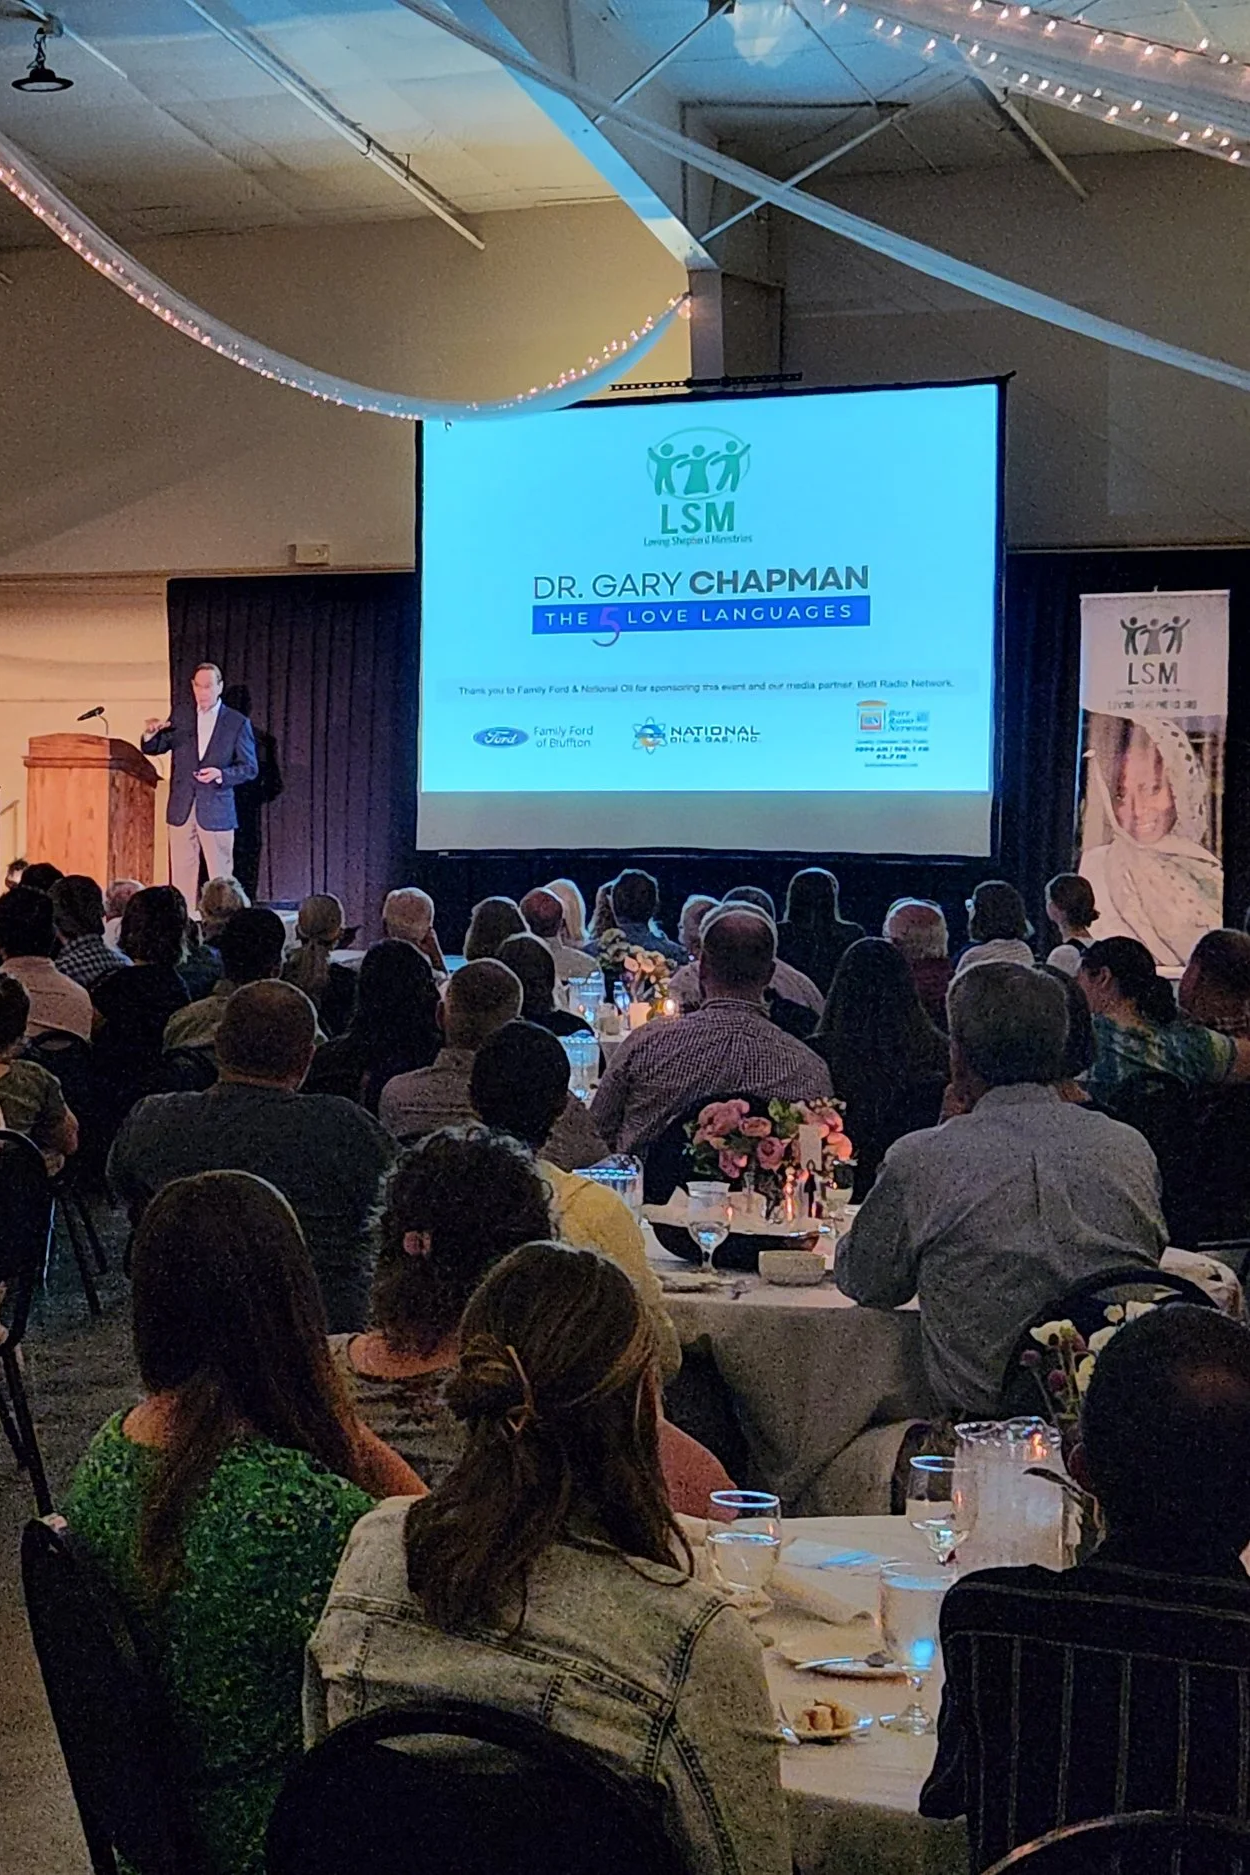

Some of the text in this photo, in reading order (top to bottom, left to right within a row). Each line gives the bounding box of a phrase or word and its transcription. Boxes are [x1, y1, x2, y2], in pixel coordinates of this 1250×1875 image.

[661, 501, 735, 534] LSM
[534, 565, 869, 599] DR. GARY CHAPMAN
[544, 604, 852, 647] THE 5 LOVE LANGUAGES
[1128, 662, 1178, 685] LSM
[572, 685, 579, 693] &
[635, 684, 647, 692] for
[748, 682, 766, 690] and
[786, 681, 816, 690] media
[484, 730, 518, 744] Ford
[533, 725, 594, 738] Family Ford
[670, 725, 761, 736] NATIONAL
[536, 738, 547, 748] of
